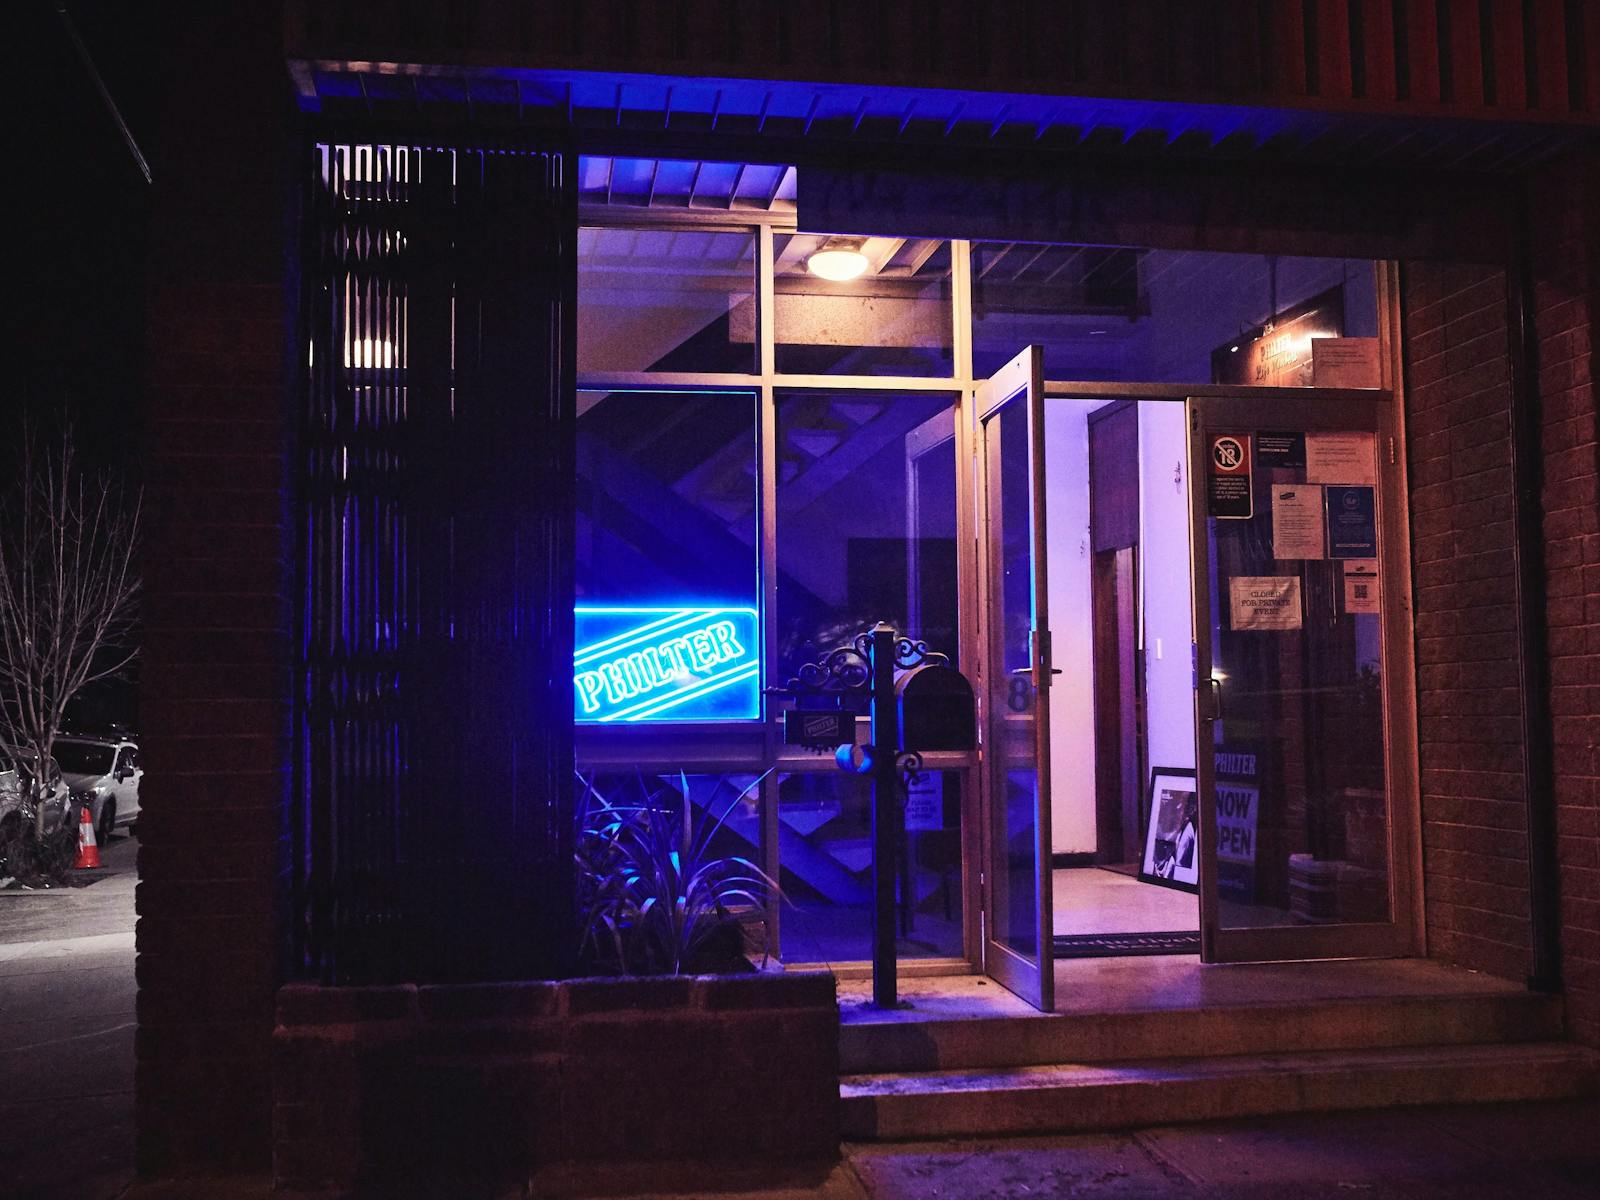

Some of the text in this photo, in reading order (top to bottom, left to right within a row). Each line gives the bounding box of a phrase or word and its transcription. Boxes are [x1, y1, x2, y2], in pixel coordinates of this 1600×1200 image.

[1241, 599, 1291, 607] FOR PRIVATE
[573, 620, 746, 713] PHILTER
[1214, 752, 1256, 775] PHILTER
[1216, 826, 1252, 856] PEN
